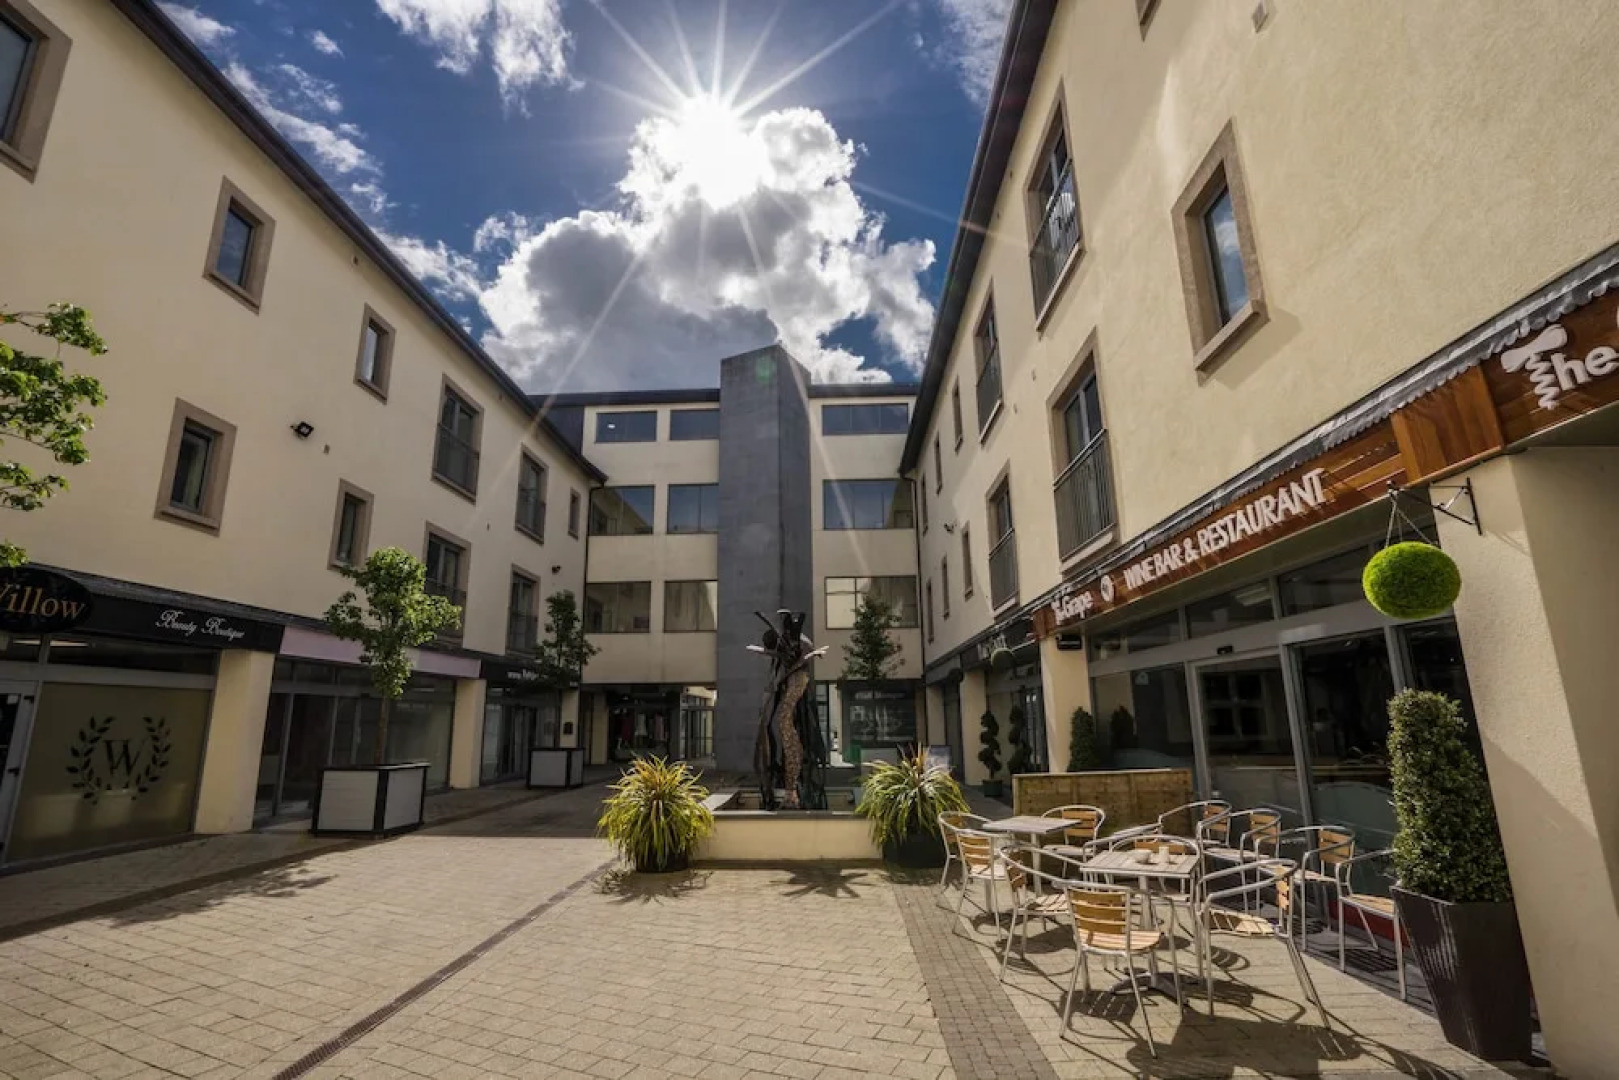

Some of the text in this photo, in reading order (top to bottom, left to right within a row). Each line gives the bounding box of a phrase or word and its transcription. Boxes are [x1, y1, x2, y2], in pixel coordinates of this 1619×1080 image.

[1123, 467, 1327, 590] WINE BAR & RESTAURANT
